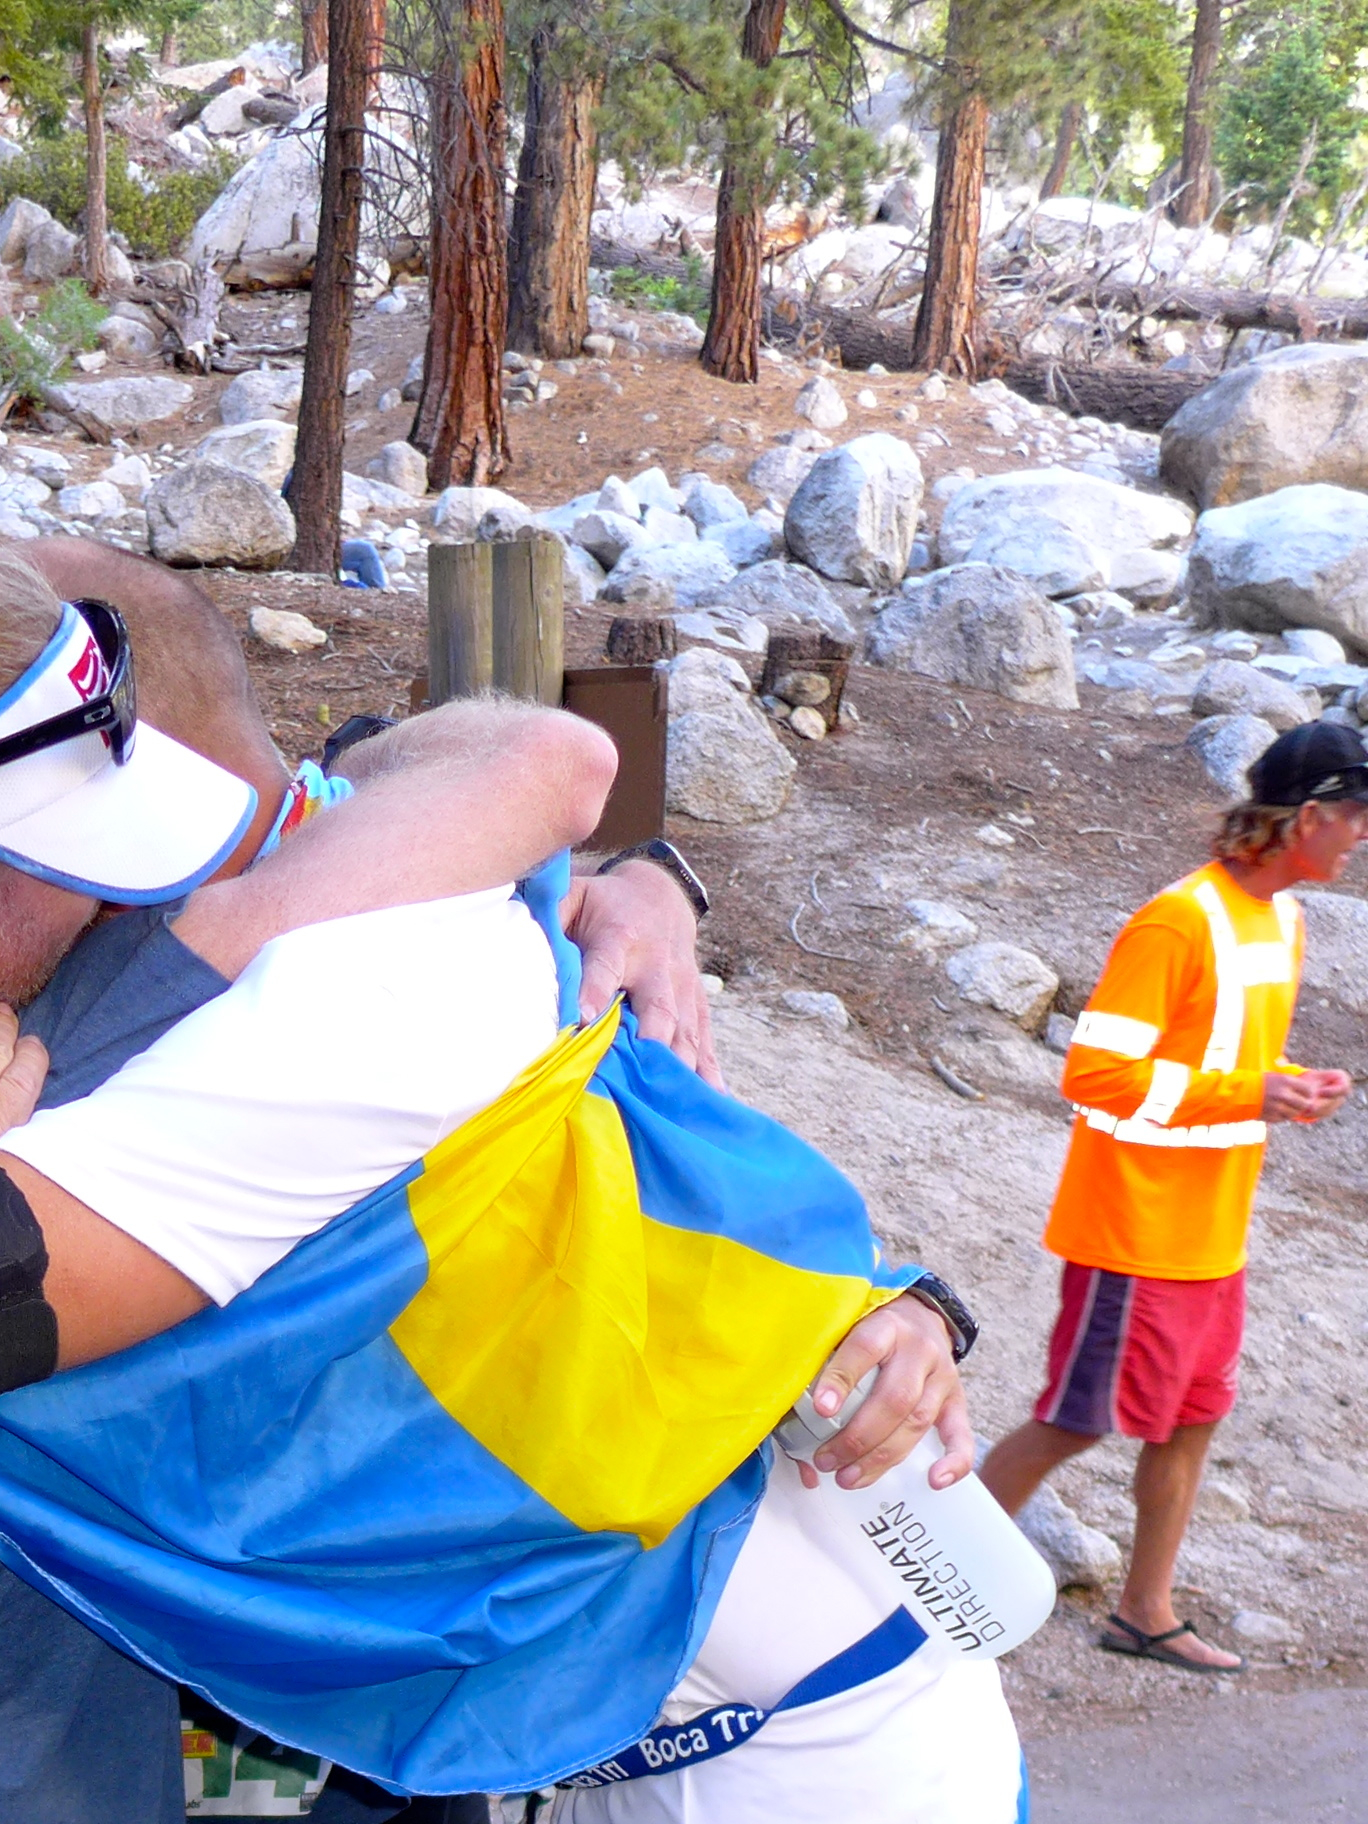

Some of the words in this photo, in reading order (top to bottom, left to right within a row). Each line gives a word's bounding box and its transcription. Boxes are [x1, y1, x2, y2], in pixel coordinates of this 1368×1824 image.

[860, 1515, 983, 1652] ULTIMATE
[885, 1501, 1006, 1643] DIRECTION
[638, 1727, 710, 1769] Boca
